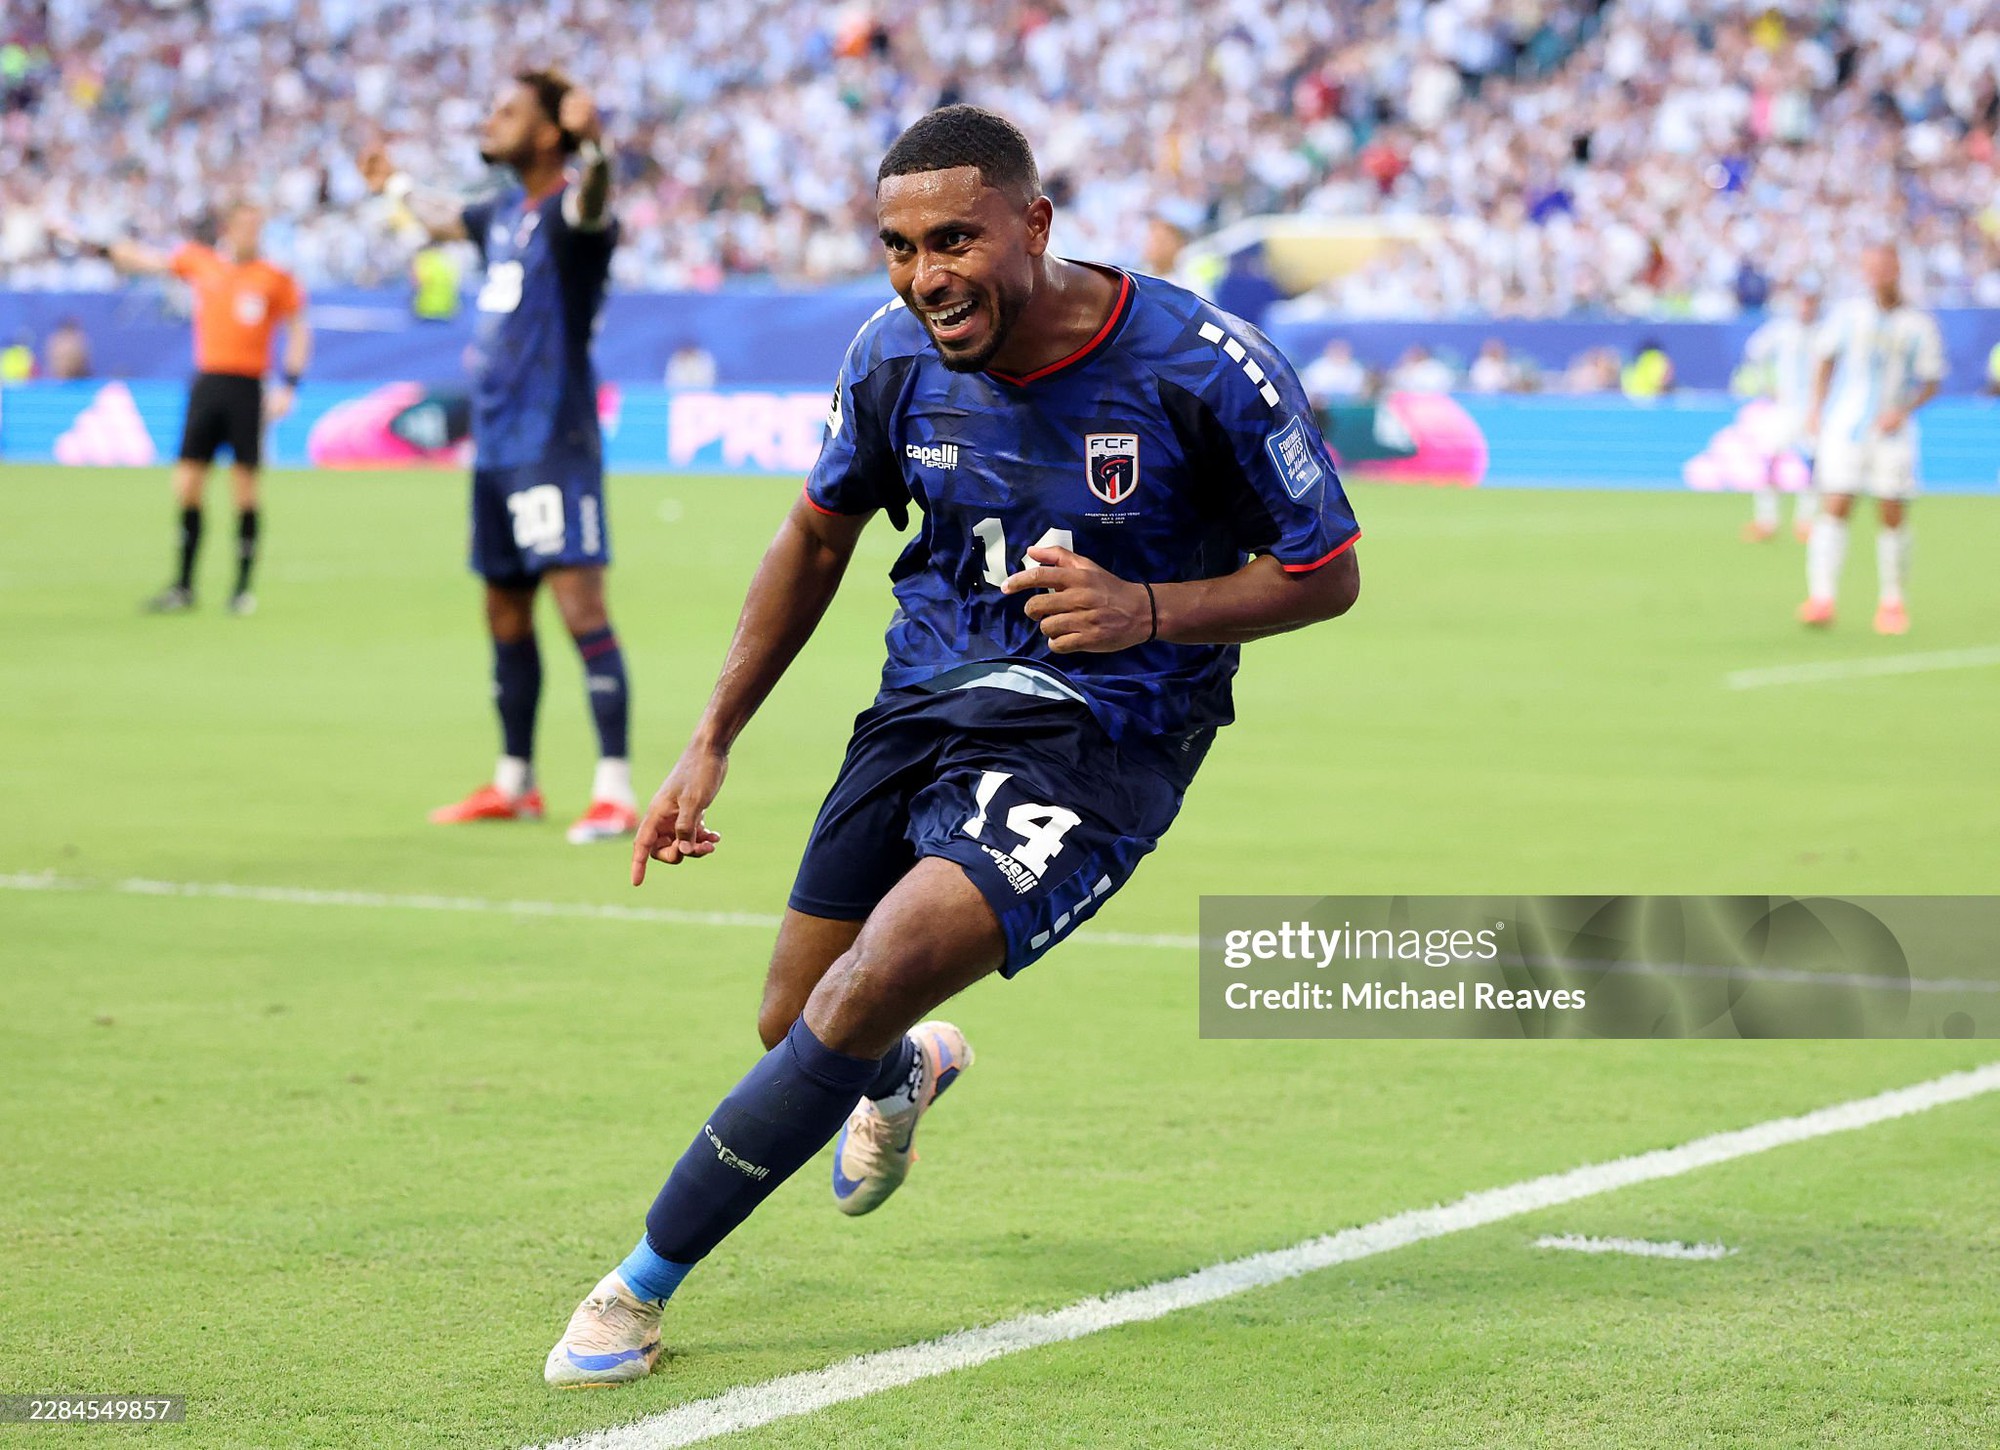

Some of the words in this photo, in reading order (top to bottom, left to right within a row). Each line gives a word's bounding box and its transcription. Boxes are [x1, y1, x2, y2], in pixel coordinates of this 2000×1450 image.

[906, 444, 958, 464] capelli
[1090, 438, 1133, 449] FCF
[1278, 427, 1300, 454] FOOTBALL
[1282, 437, 1304, 466] UNITES
[926, 461, 957, 470] SPORT
[962, 770, 1082, 879] 14
[997, 863, 1024, 895] SPORT
[705, 1124, 770, 1179] capelli
